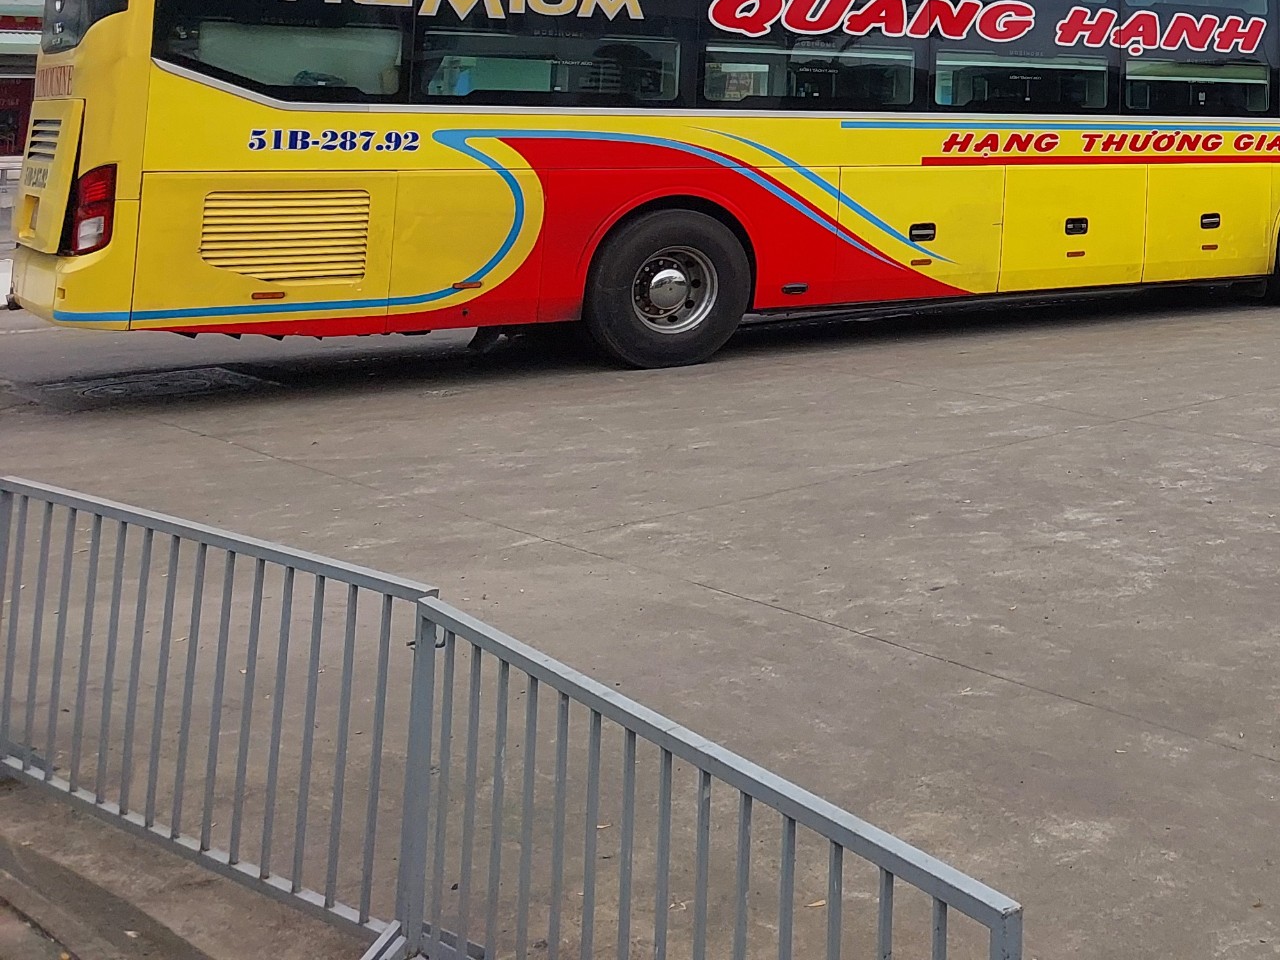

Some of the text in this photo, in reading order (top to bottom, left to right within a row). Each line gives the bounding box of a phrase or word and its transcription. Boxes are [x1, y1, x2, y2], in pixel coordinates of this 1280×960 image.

[1054, 6, 1267, 57] HẠNH
[247, 128, 420, 152] 51B-287.92
[941, 132, 1060, 158] HẠNG
[1081, 129, 1224, 154] THƯƠNG
